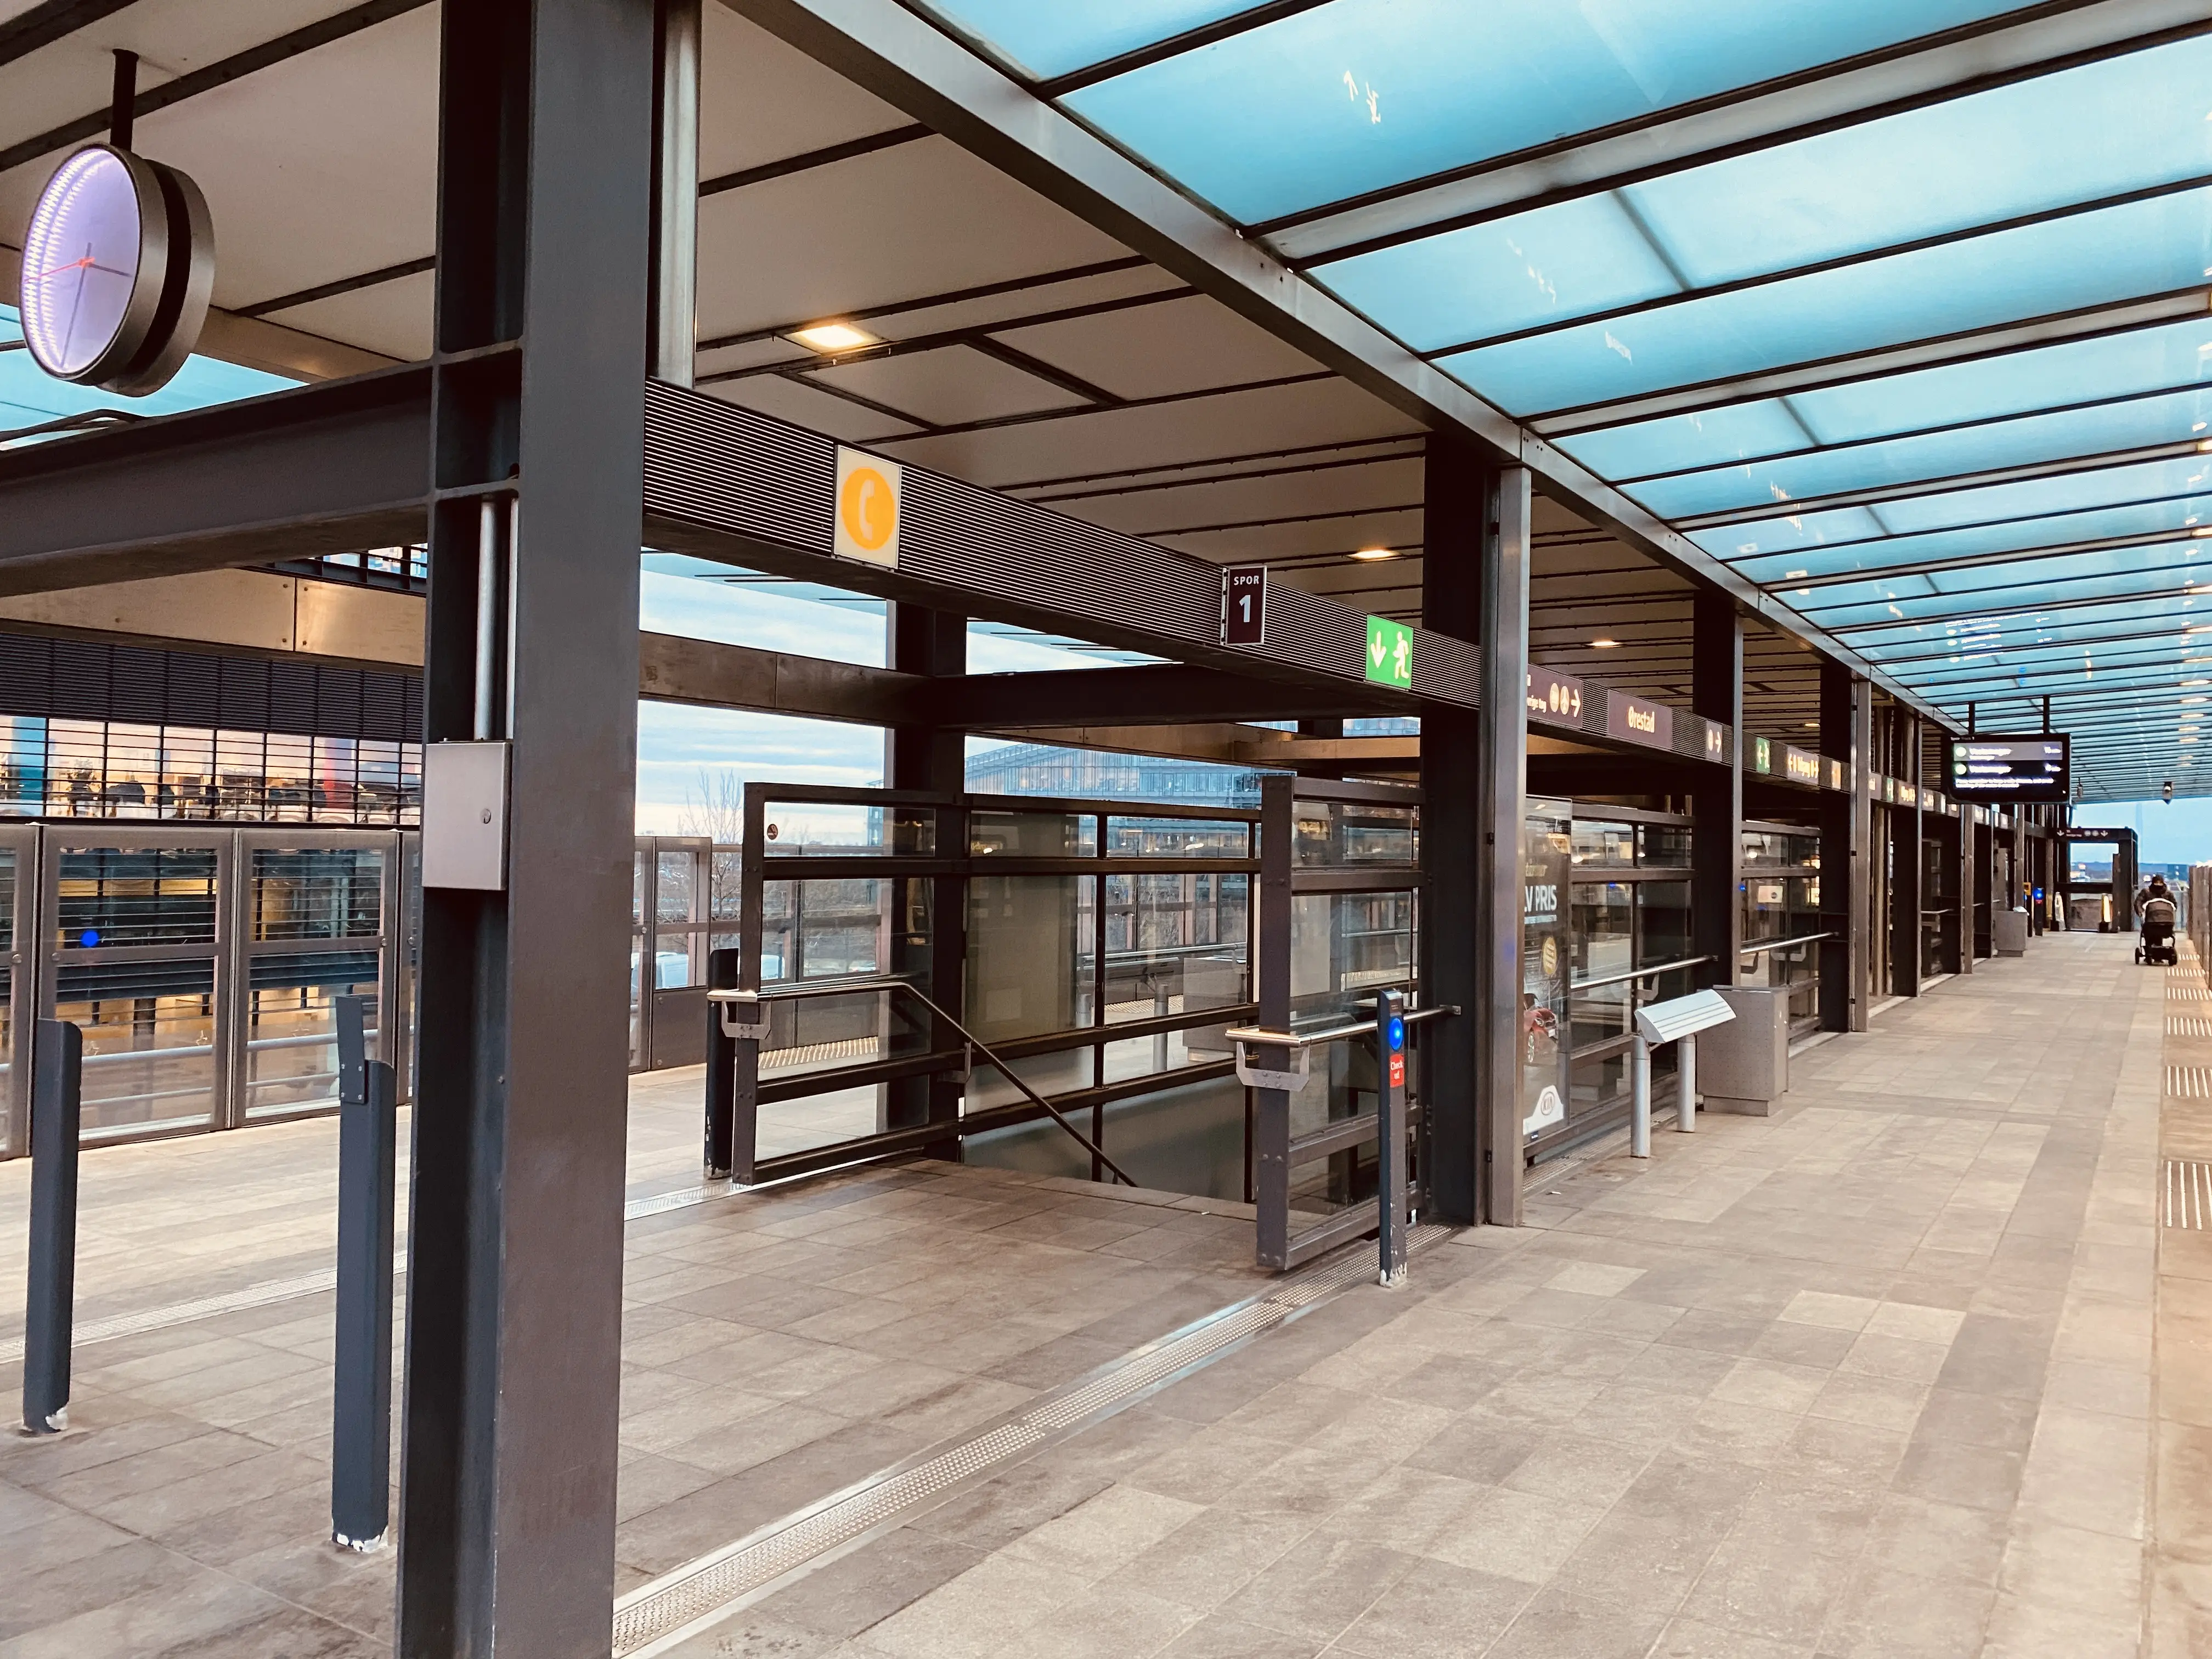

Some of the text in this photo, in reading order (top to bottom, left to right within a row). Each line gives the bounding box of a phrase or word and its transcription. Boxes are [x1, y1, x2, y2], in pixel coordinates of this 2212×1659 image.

[1233, 575, 1260, 586] SPOR
[1239, 594, 1251, 623] 1
[1628, 706, 1655, 733] Ørestad
[1535, 884, 1557, 911] PRIS
[1390, 1060, 1403, 1070] Check
